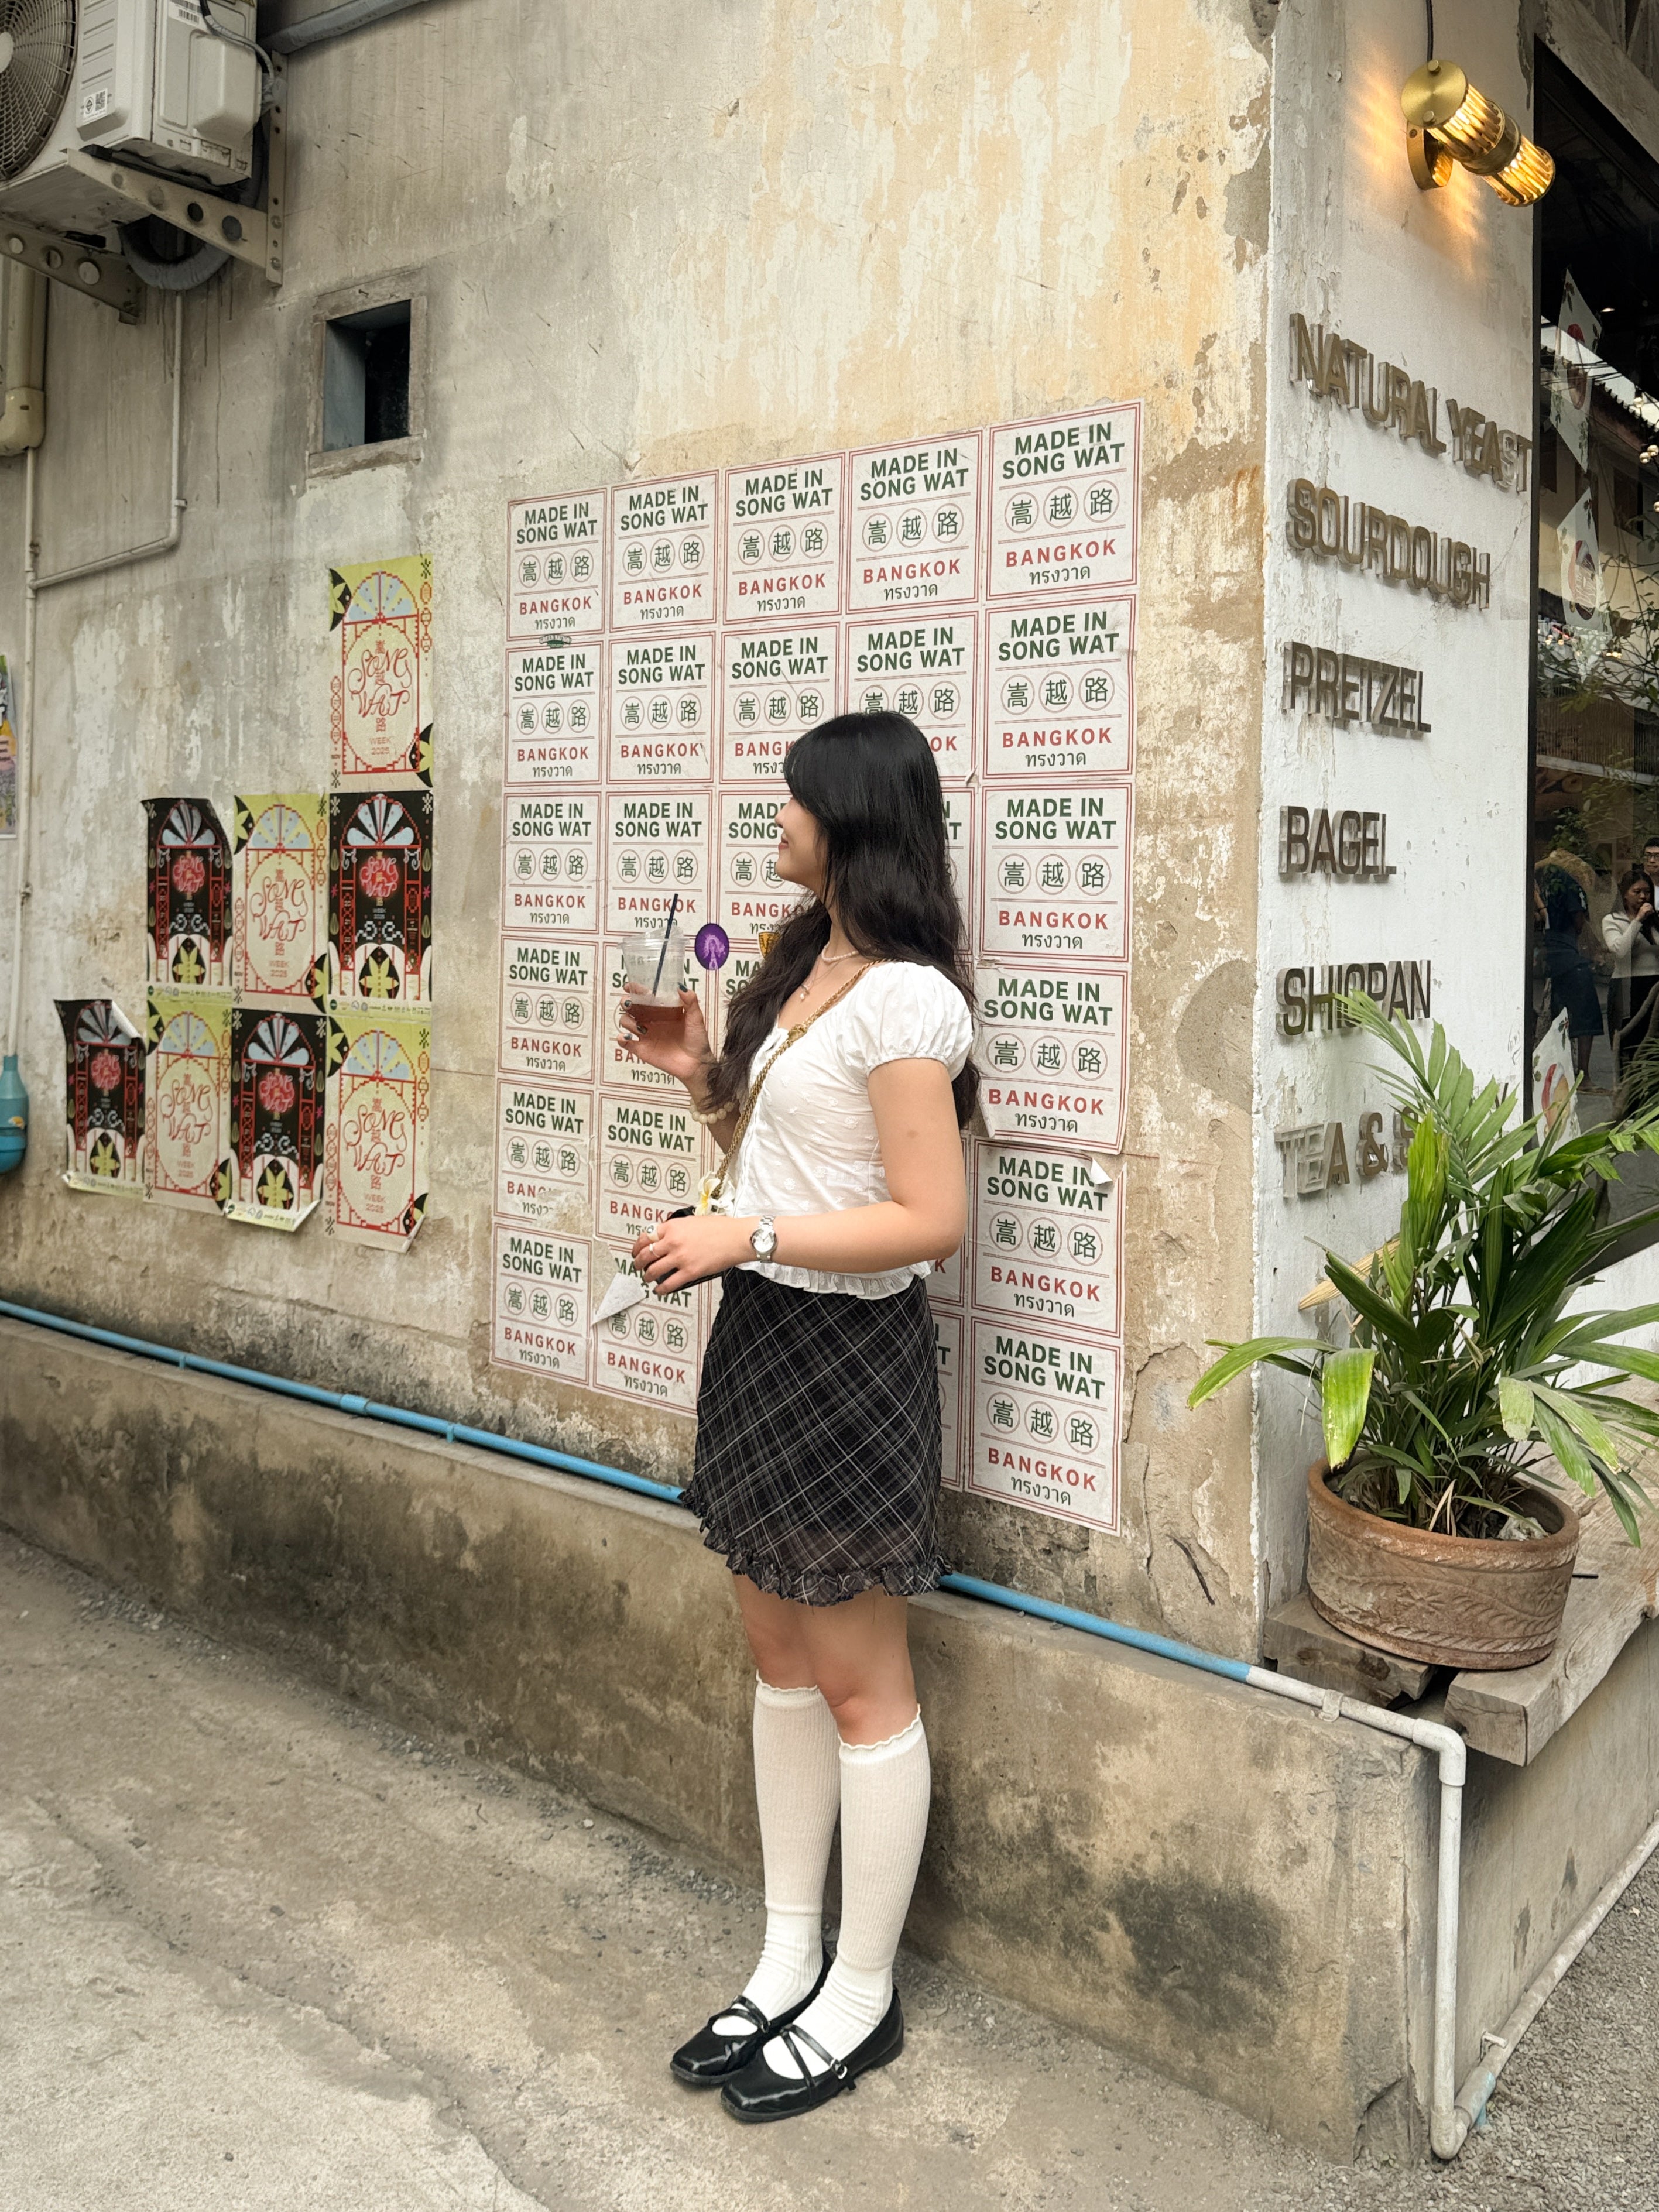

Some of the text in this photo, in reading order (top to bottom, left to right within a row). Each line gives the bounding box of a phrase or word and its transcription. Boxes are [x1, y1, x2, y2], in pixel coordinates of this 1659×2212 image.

[1290, 313, 1533, 493] NATURAL YEAST
[1014, 421, 1112, 456] MADE IN
[871, 448, 957, 479] MADE IN
[1002, 443, 1125, 480] SONG WAT
[745, 468, 822, 496] MADE IN
[860, 468, 969, 501] SONG WAT
[629, 485, 699, 512] MADE IN
[735, 488, 834, 517] SONG WAT
[525, 502, 589, 526] MADE IN
[621, 503, 708, 531] SONG WAT
[516, 519, 598, 545] SONG WAT
[1288, 478, 1490, 609] SOURDOUGH
[1006, 539, 1115, 568] BANGKOK
[863, 558, 960, 584] BANGKOK
[1029, 565, 1090, 585] ทรงวาด
[623, 584, 702, 605] BANGKOK
[739, 573, 825, 596] BANGKOK
[883, 584, 938, 601] ทรงวาด
[519, 596, 592, 615] BANGKOK
[640, 605, 684, 620] ทรงวาด
[757, 596, 805, 612] ทรงวาด
[534, 616, 575, 630] ทรงวาด
[1010, 611, 1106, 639] MADE IN
[741, 636, 818, 659] MADE IN
[868, 626, 954, 651] MADE IN
[999, 633, 1120, 661] SONG WAT
[522, 653, 585, 673] MADE IN
[627, 644, 696, 666] MADE IN
[857, 647, 965, 673] SONG WAT
[348, 648, 413, 693] SONG
[618, 663, 705, 685] SONG WAT
[732, 656, 828, 680] SONG WAT
[515, 671, 594, 692] SONG WAT
[1284, 642, 1431, 733] PRETZEL
[351, 684, 410, 718] WAT
[621, 743, 699, 758] BANGKOK
[1002, 728, 1111, 748] BANGKOK
[517, 746, 588, 762] BANGKOK
[1025, 752, 1086, 767] ทรงวาด
[532, 766, 573, 777] ทรงวาด
[637, 763, 681, 774] ทรงวาด
[520, 803, 583, 819] MADE IN
[623, 802, 693, 819] MADE IN
[1007, 798, 1103, 818] MADE IN
[512, 821, 592, 837] SONG WAT
[615, 821, 702, 838] SONG WAT
[728, 821, 778, 839] SONG
[995, 820, 1116, 840] SONG WAT
[1279, 805, 1397, 877] BAGEL
[250, 876, 309, 918] SONG
[515, 894, 585, 908] BANGKOK
[618, 897, 695, 913] BANGKOK
[252, 910, 307, 942] WAT
[529, 913, 569, 924] ทรงวาด
[999, 910, 1108, 930] BANGKOK
[1022, 934, 1082, 949] ทรงวาด
[517, 947, 580, 967] MADE IN
[509, 963, 588, 986] SONG WAT
[999, 978, 1101, 1002] MADE IN
[984, 997, 1113, 1026] SONG WAT
[511, 1037, 581, 1057] BANGKOK
[526, 1057, 565, 1072] ทรงวาด
[160, 1079, 214, 1123] SONG
[513, 1091, 575, 1115] MADE IN
[988, 1089, 1104, 1115] BANGKOK
[162, 1113, 211, 1145] WAT
[343, 1104, 408, 1152] SONG
[505, 1107, 584, 1134] SONG WAT
[616, 1107, 686, 1132] MADE IN
[1014, 1113, 1079, 1132] ทรงวาด
[608, 1124, 695, 1153] SONG WAT
[346, 1142, 405, 1177] WAT
[1274, 1122, 1350, 1198] TEA
[1356, 1112, 1389, 1177] &
[999, 1155, 1095, 1187] MADE IN
[364, 1193, 386, 1203] WEEK
[987, 1176, 1108, 1212] SONG WAT
[510, 1237, 574, 1264] MADE IN
[502, 1253, 582, 1284] SONG WAT
[991, 1266, 1099, 1301] BANGKOK
[656, 1285, 692, 1308] WAT
[1014, 1293, 1074, 1318] ทรงวาด
[504, 1326, 576, 1356] BANGKOK
[519, 1349, 560, 1369] ทรงวาด
[996, 1335, 1092, 1374] MADE IN
[607, 1351, 685, 1384] BANGKOK
[984, 1356, 1106, 1400] SONG WAT
[623, 1375, 667, 1397] ทรงวาด
[988, 1447, 1096, 1491] BANGKOK
[1010, 1476, 1071, 1506] ทรงวาด
